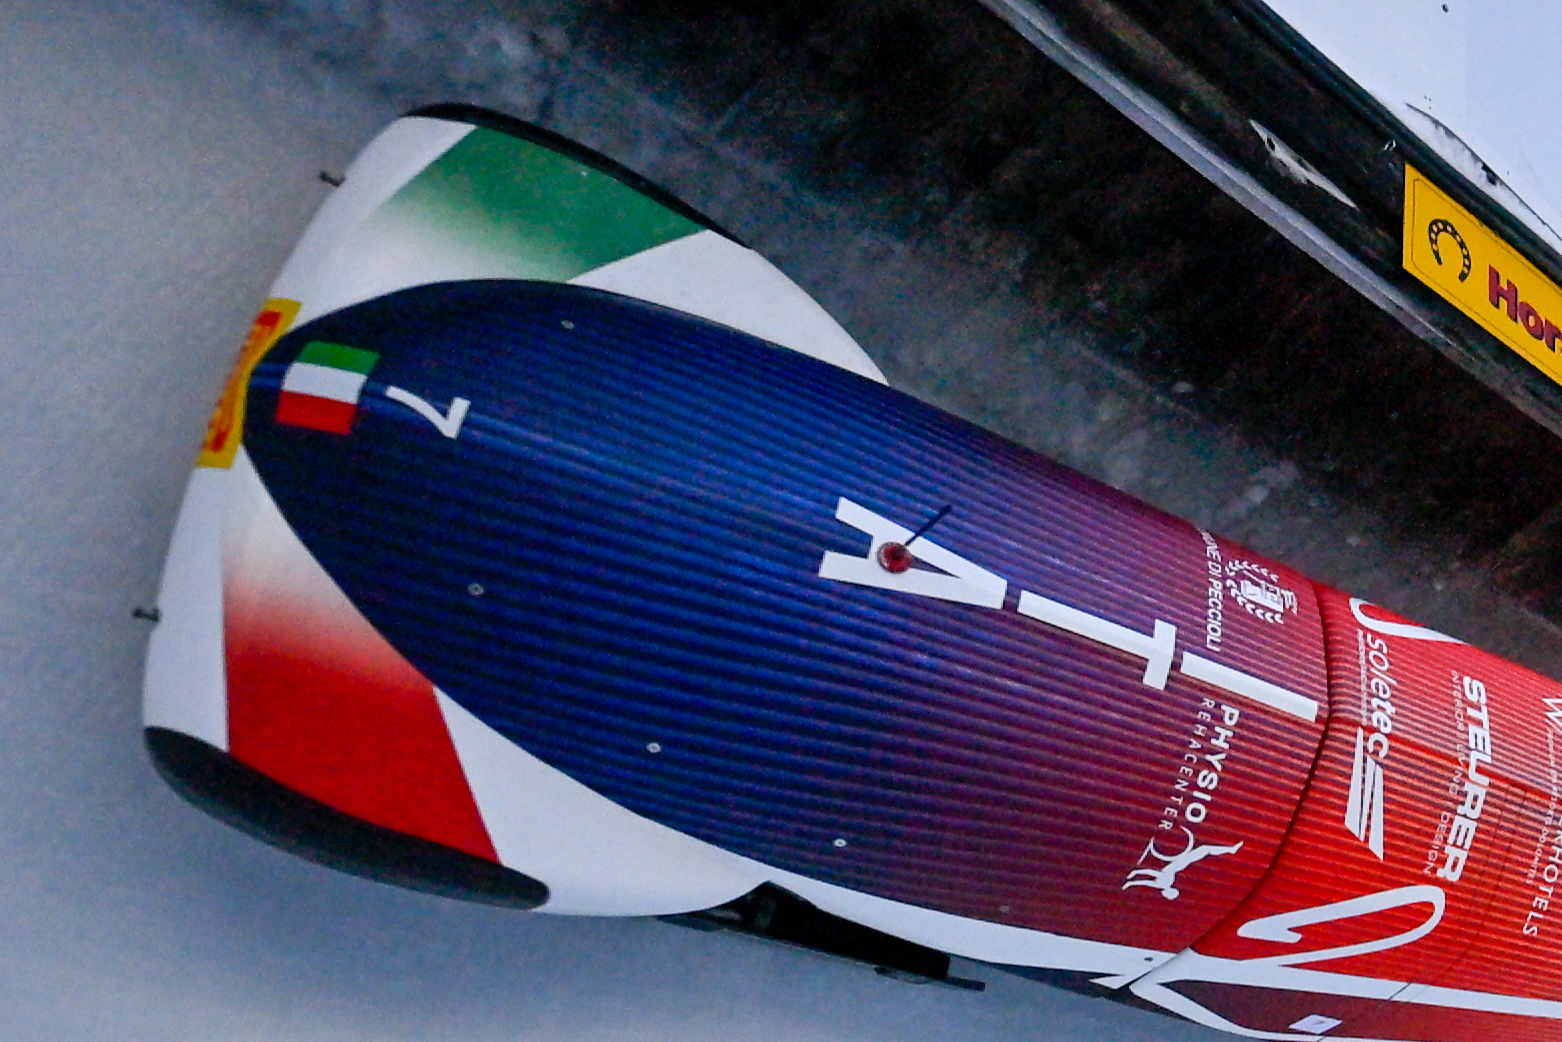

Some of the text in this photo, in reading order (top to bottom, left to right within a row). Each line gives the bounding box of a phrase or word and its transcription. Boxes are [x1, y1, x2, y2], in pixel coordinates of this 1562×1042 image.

[385, 384, 472, 440] 7
[1206, 578, 1224, 652] PECCIOLI
[1207, 561, 1222, 578] DI
[1366, 633, 1399, 759] soletec
[1158, 697, 1216, 830] REHACENTER
[1185, 704, 1240, 823] PHYSIO
[1436, 676, 1492, 883] STEURER
[1423, 811, 1451, 875] DESIGN
